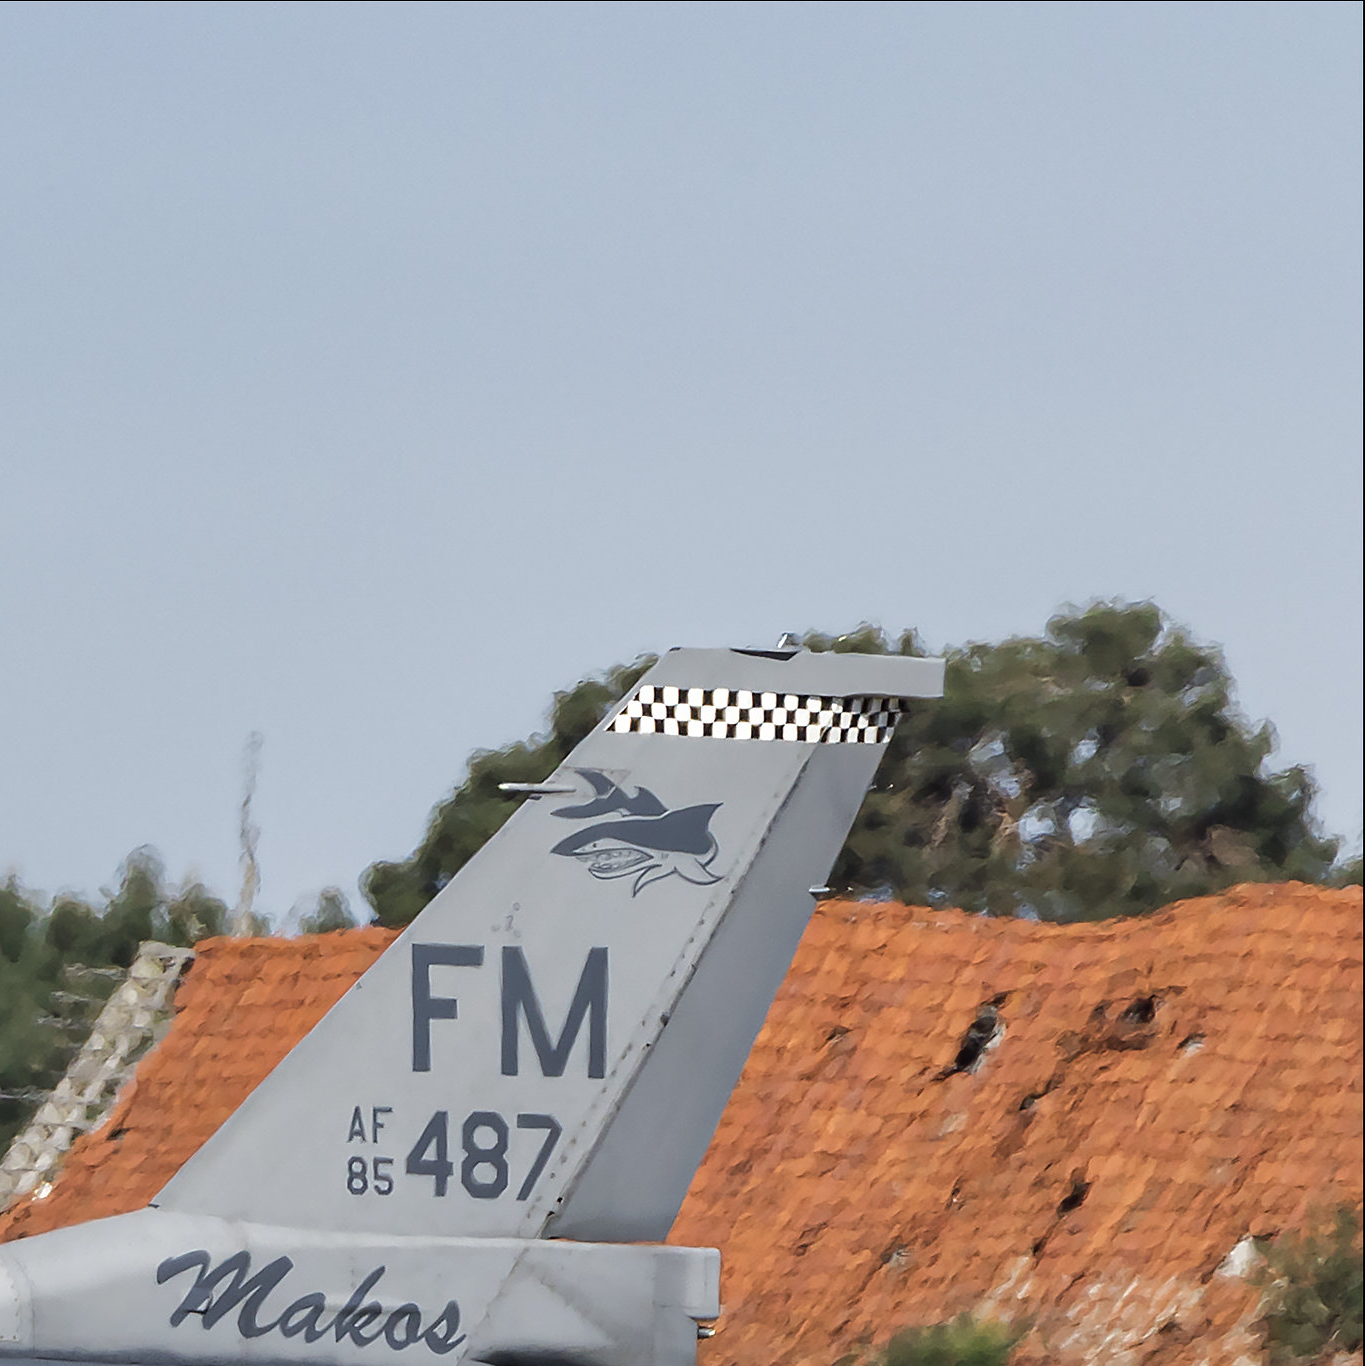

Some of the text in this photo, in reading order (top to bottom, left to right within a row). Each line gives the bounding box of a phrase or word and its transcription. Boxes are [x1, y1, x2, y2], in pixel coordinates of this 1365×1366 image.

[412, 943, 609, 1079] FM
[346, 1105, 394, 1143] AF
[405, 1110, 563, 1201] 487
[346, 1156, 394, 1196] 85
[157, 1249, 467, 1355] Makos
